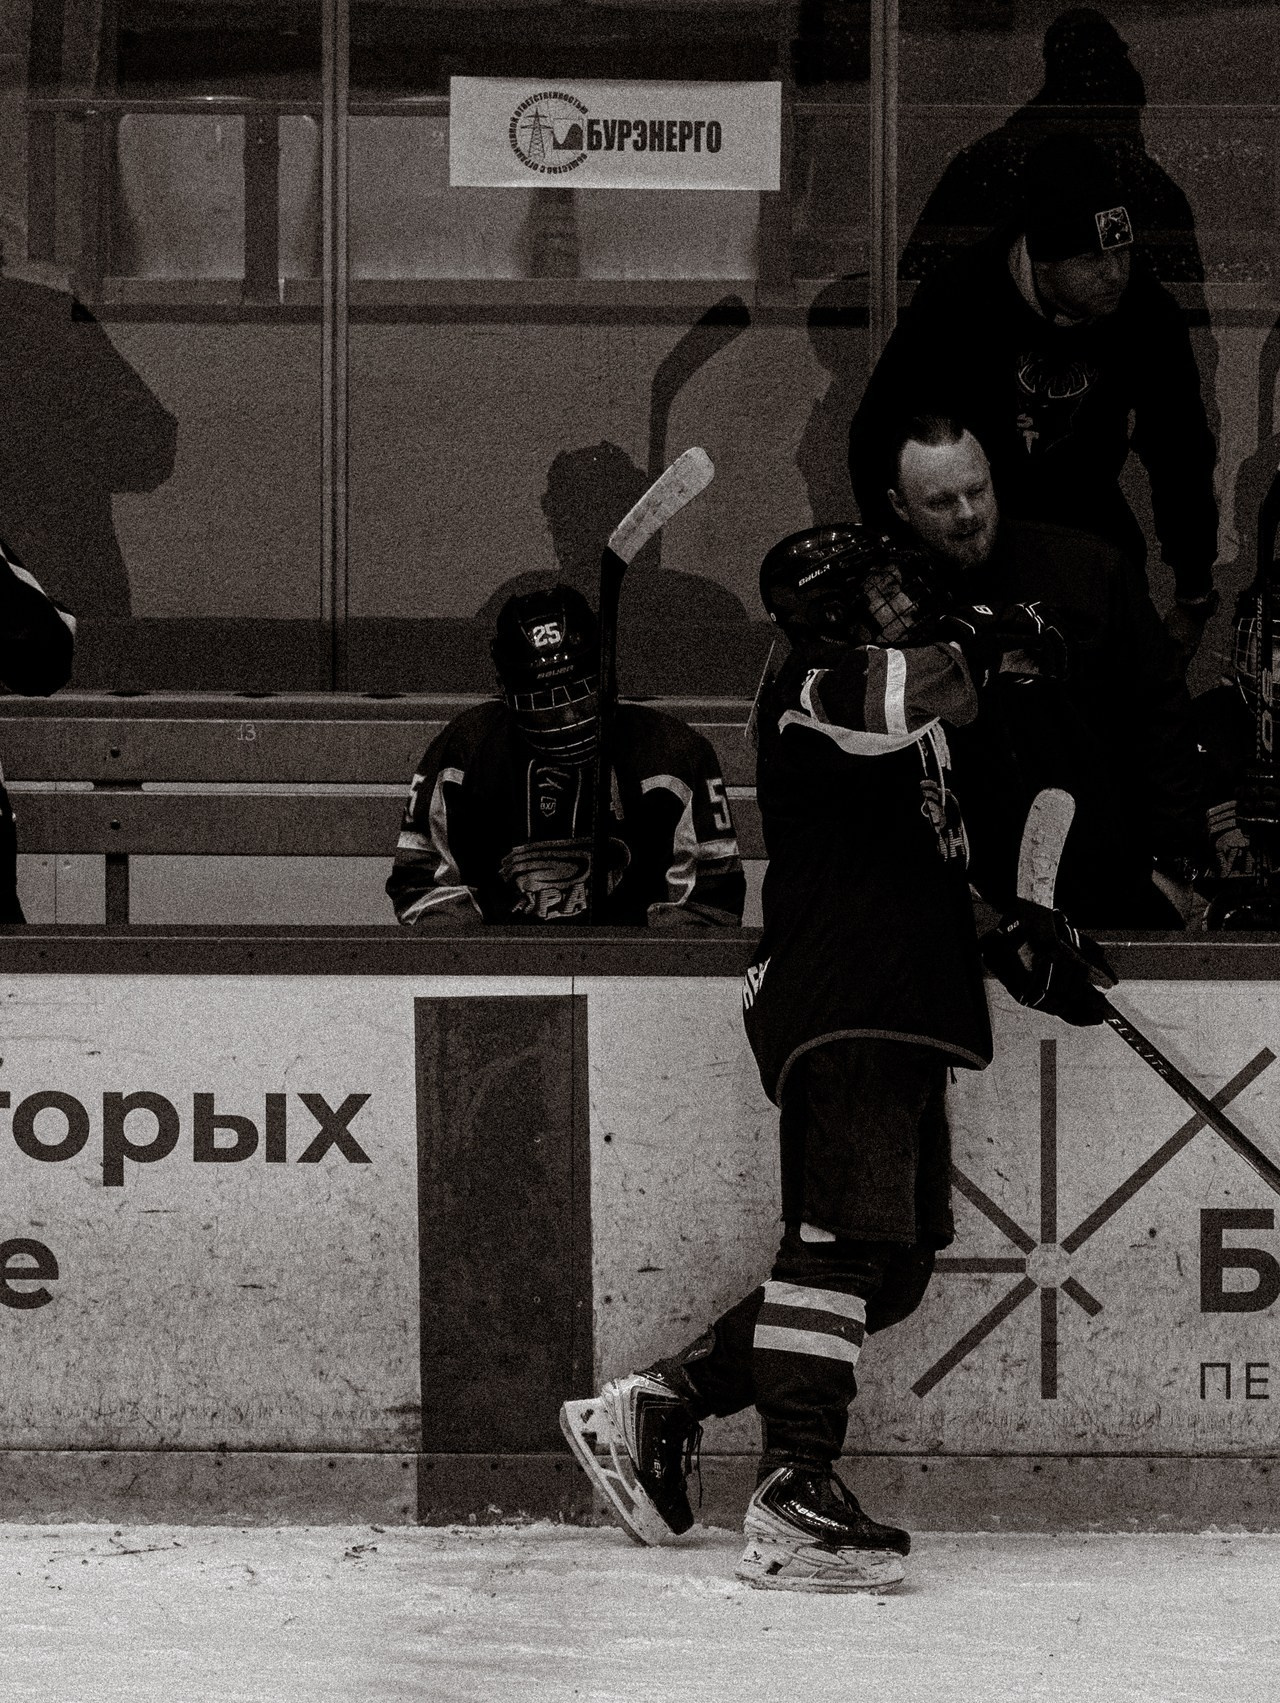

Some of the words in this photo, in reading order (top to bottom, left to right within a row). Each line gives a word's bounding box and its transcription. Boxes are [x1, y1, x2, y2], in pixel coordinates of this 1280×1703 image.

[586, 118, 722, 153] БУРЭНЕРГО
[532, 622, 561, 648] 25
[237, 723, 257, 741] 13
[705, 777, 732, 831] 5
